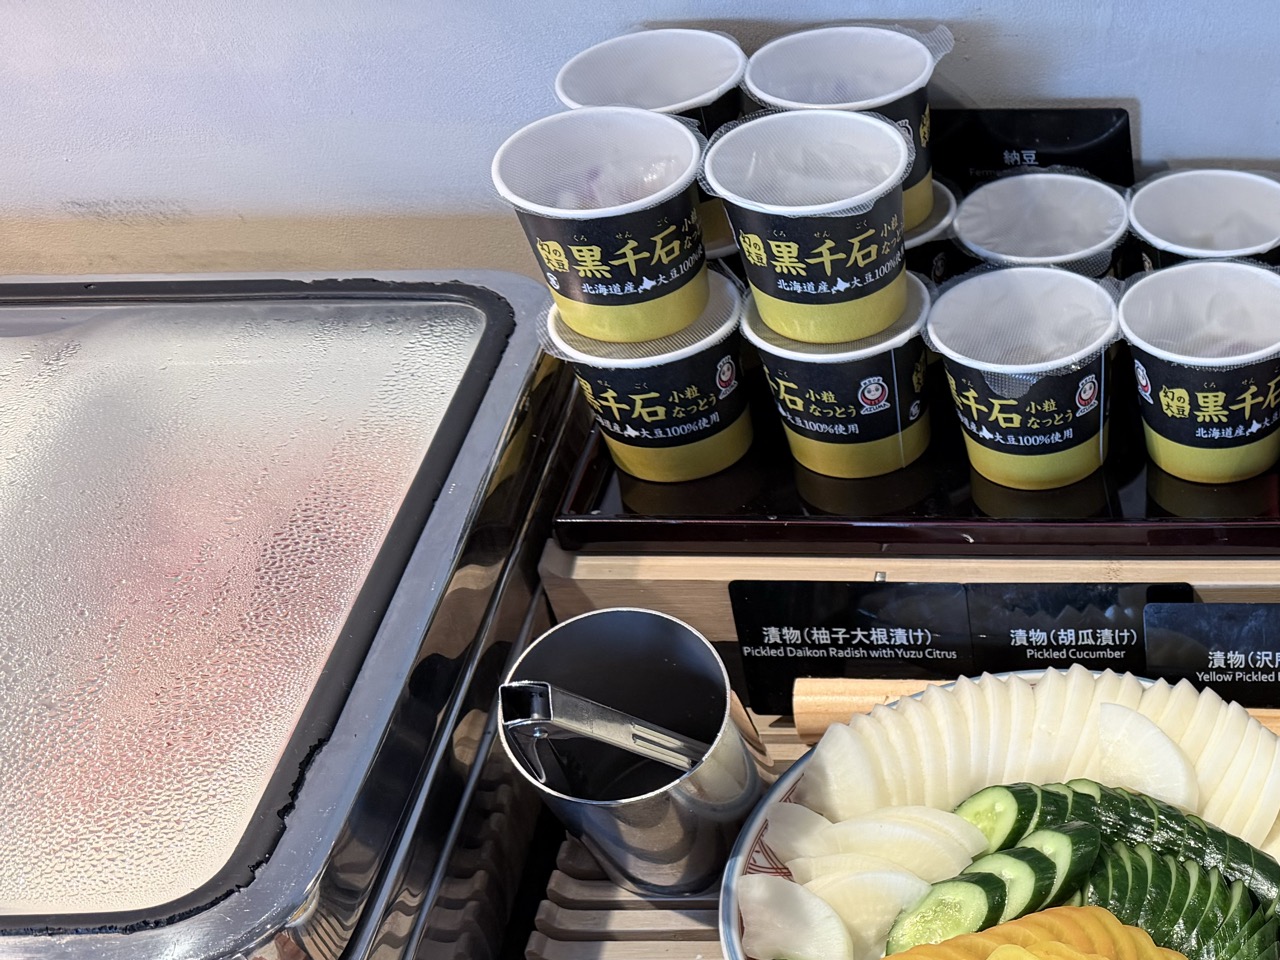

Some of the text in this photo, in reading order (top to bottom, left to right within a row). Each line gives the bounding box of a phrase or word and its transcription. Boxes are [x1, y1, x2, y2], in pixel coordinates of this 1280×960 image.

[1003, 150, 1039, 165] 納豆
[567, 225, 681, 279] 黒千石
[767, 229, 879, 276] 黒千石
[582, 283, 637, 296] 北海道産
[777, 279, 831, 294] 北海道産
[668, 385, 700, 404] 小粒
[805, 388, 838, 404] 小粒
[673, 394, 717, 419] なっとう
[809, 404, 857, 418] なっとう
[1025, 399, 1057, 414] 小粒
[1027, 410, 1073, 429] なっとう
[1195, 425, 1245, 439] 北海道産
[743, 647, 957, 659] Pickled Daikon Radish with Yuzu Citrus
[1026, 649, 1126, 659] Pickled Cucumber
[1196, 672, 1233, 682] Yellow
[1235, 671, 1276, 682] Pickled
